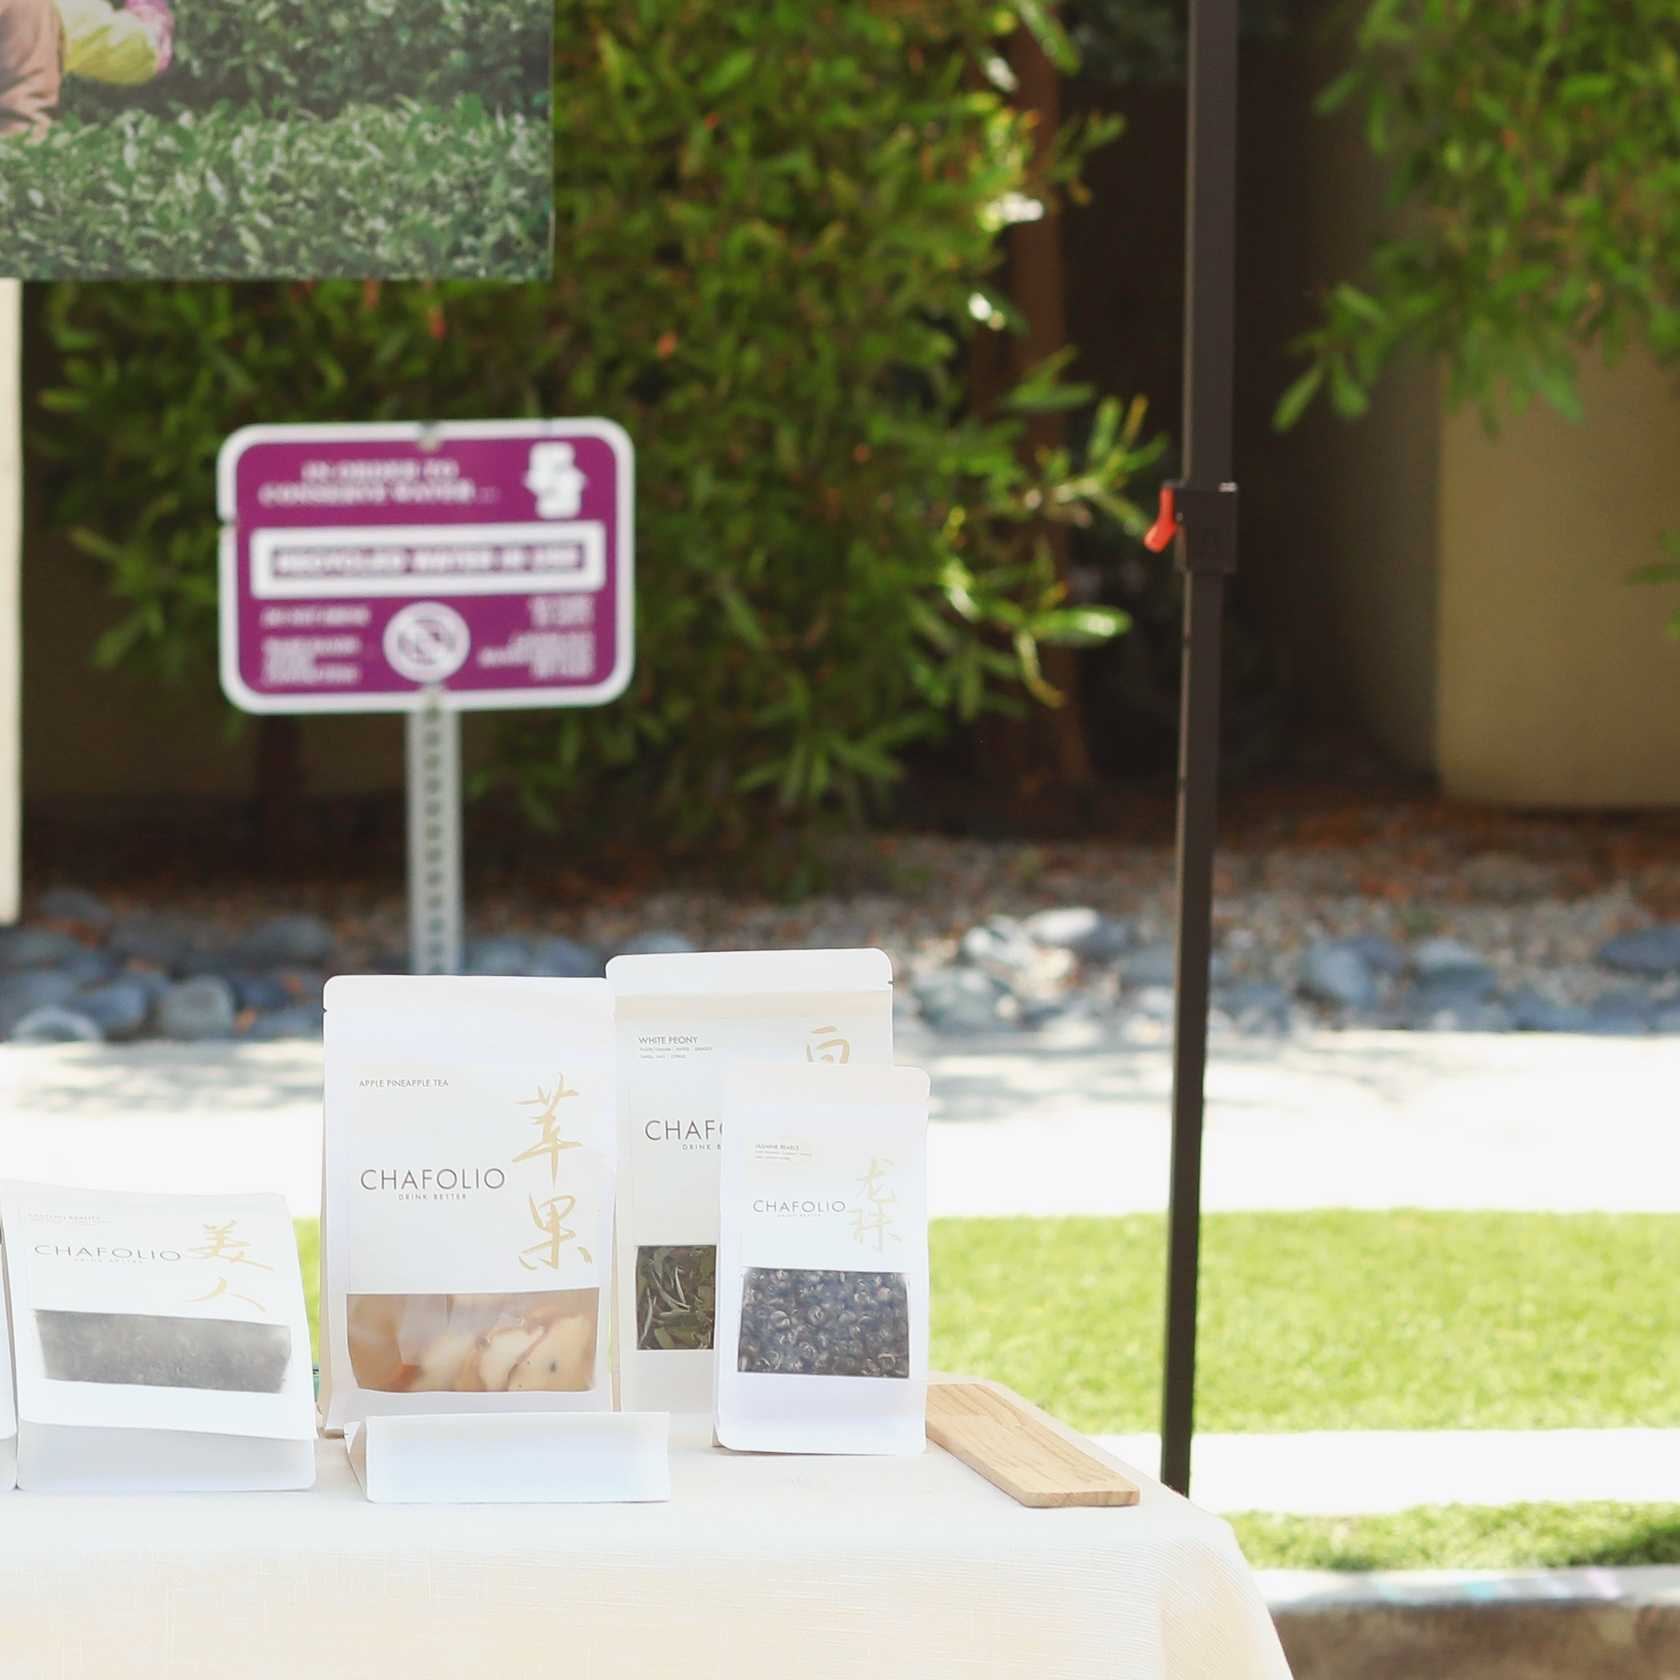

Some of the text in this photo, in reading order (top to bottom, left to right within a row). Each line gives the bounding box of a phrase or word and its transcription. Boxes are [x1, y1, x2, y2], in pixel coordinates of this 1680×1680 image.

[360, 1167, 506, 1191] CHAFOLIO
[752, 1199, 846, 1214] CHAFOLIO
[34, 1244, 182, 1262] CHAFOLIO
